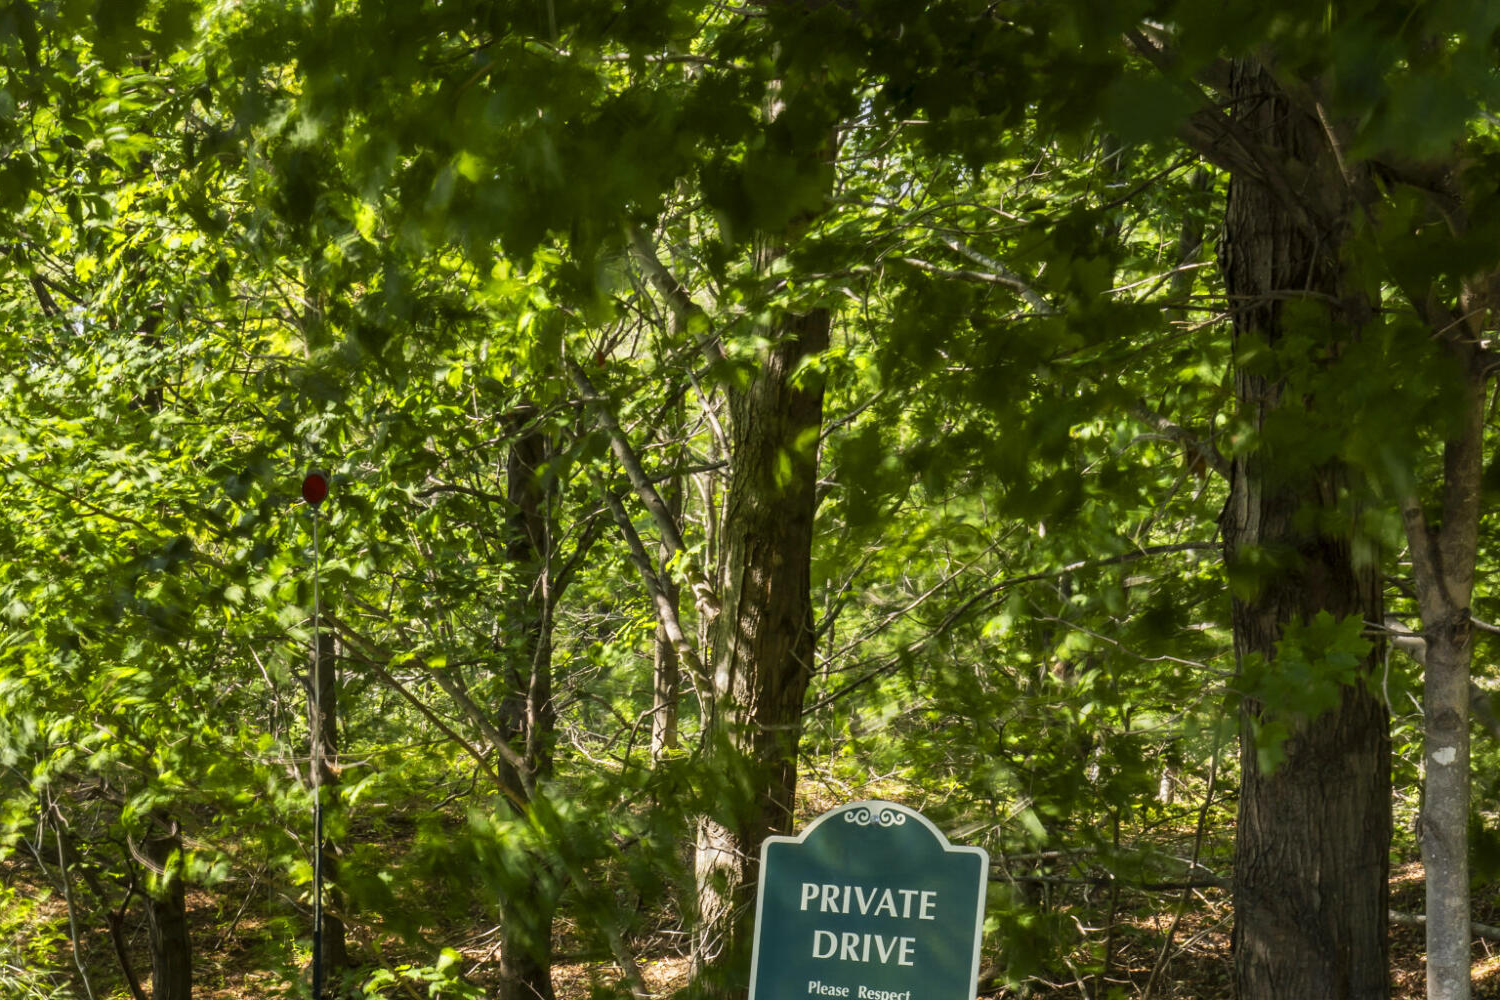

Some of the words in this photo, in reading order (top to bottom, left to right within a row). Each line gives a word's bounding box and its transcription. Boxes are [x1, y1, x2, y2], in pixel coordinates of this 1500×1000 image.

[800, 882, 937, 920] PRIVATE
[812, 929, 916, 966] DRIVE
[808, 980, 850, 997] Please
